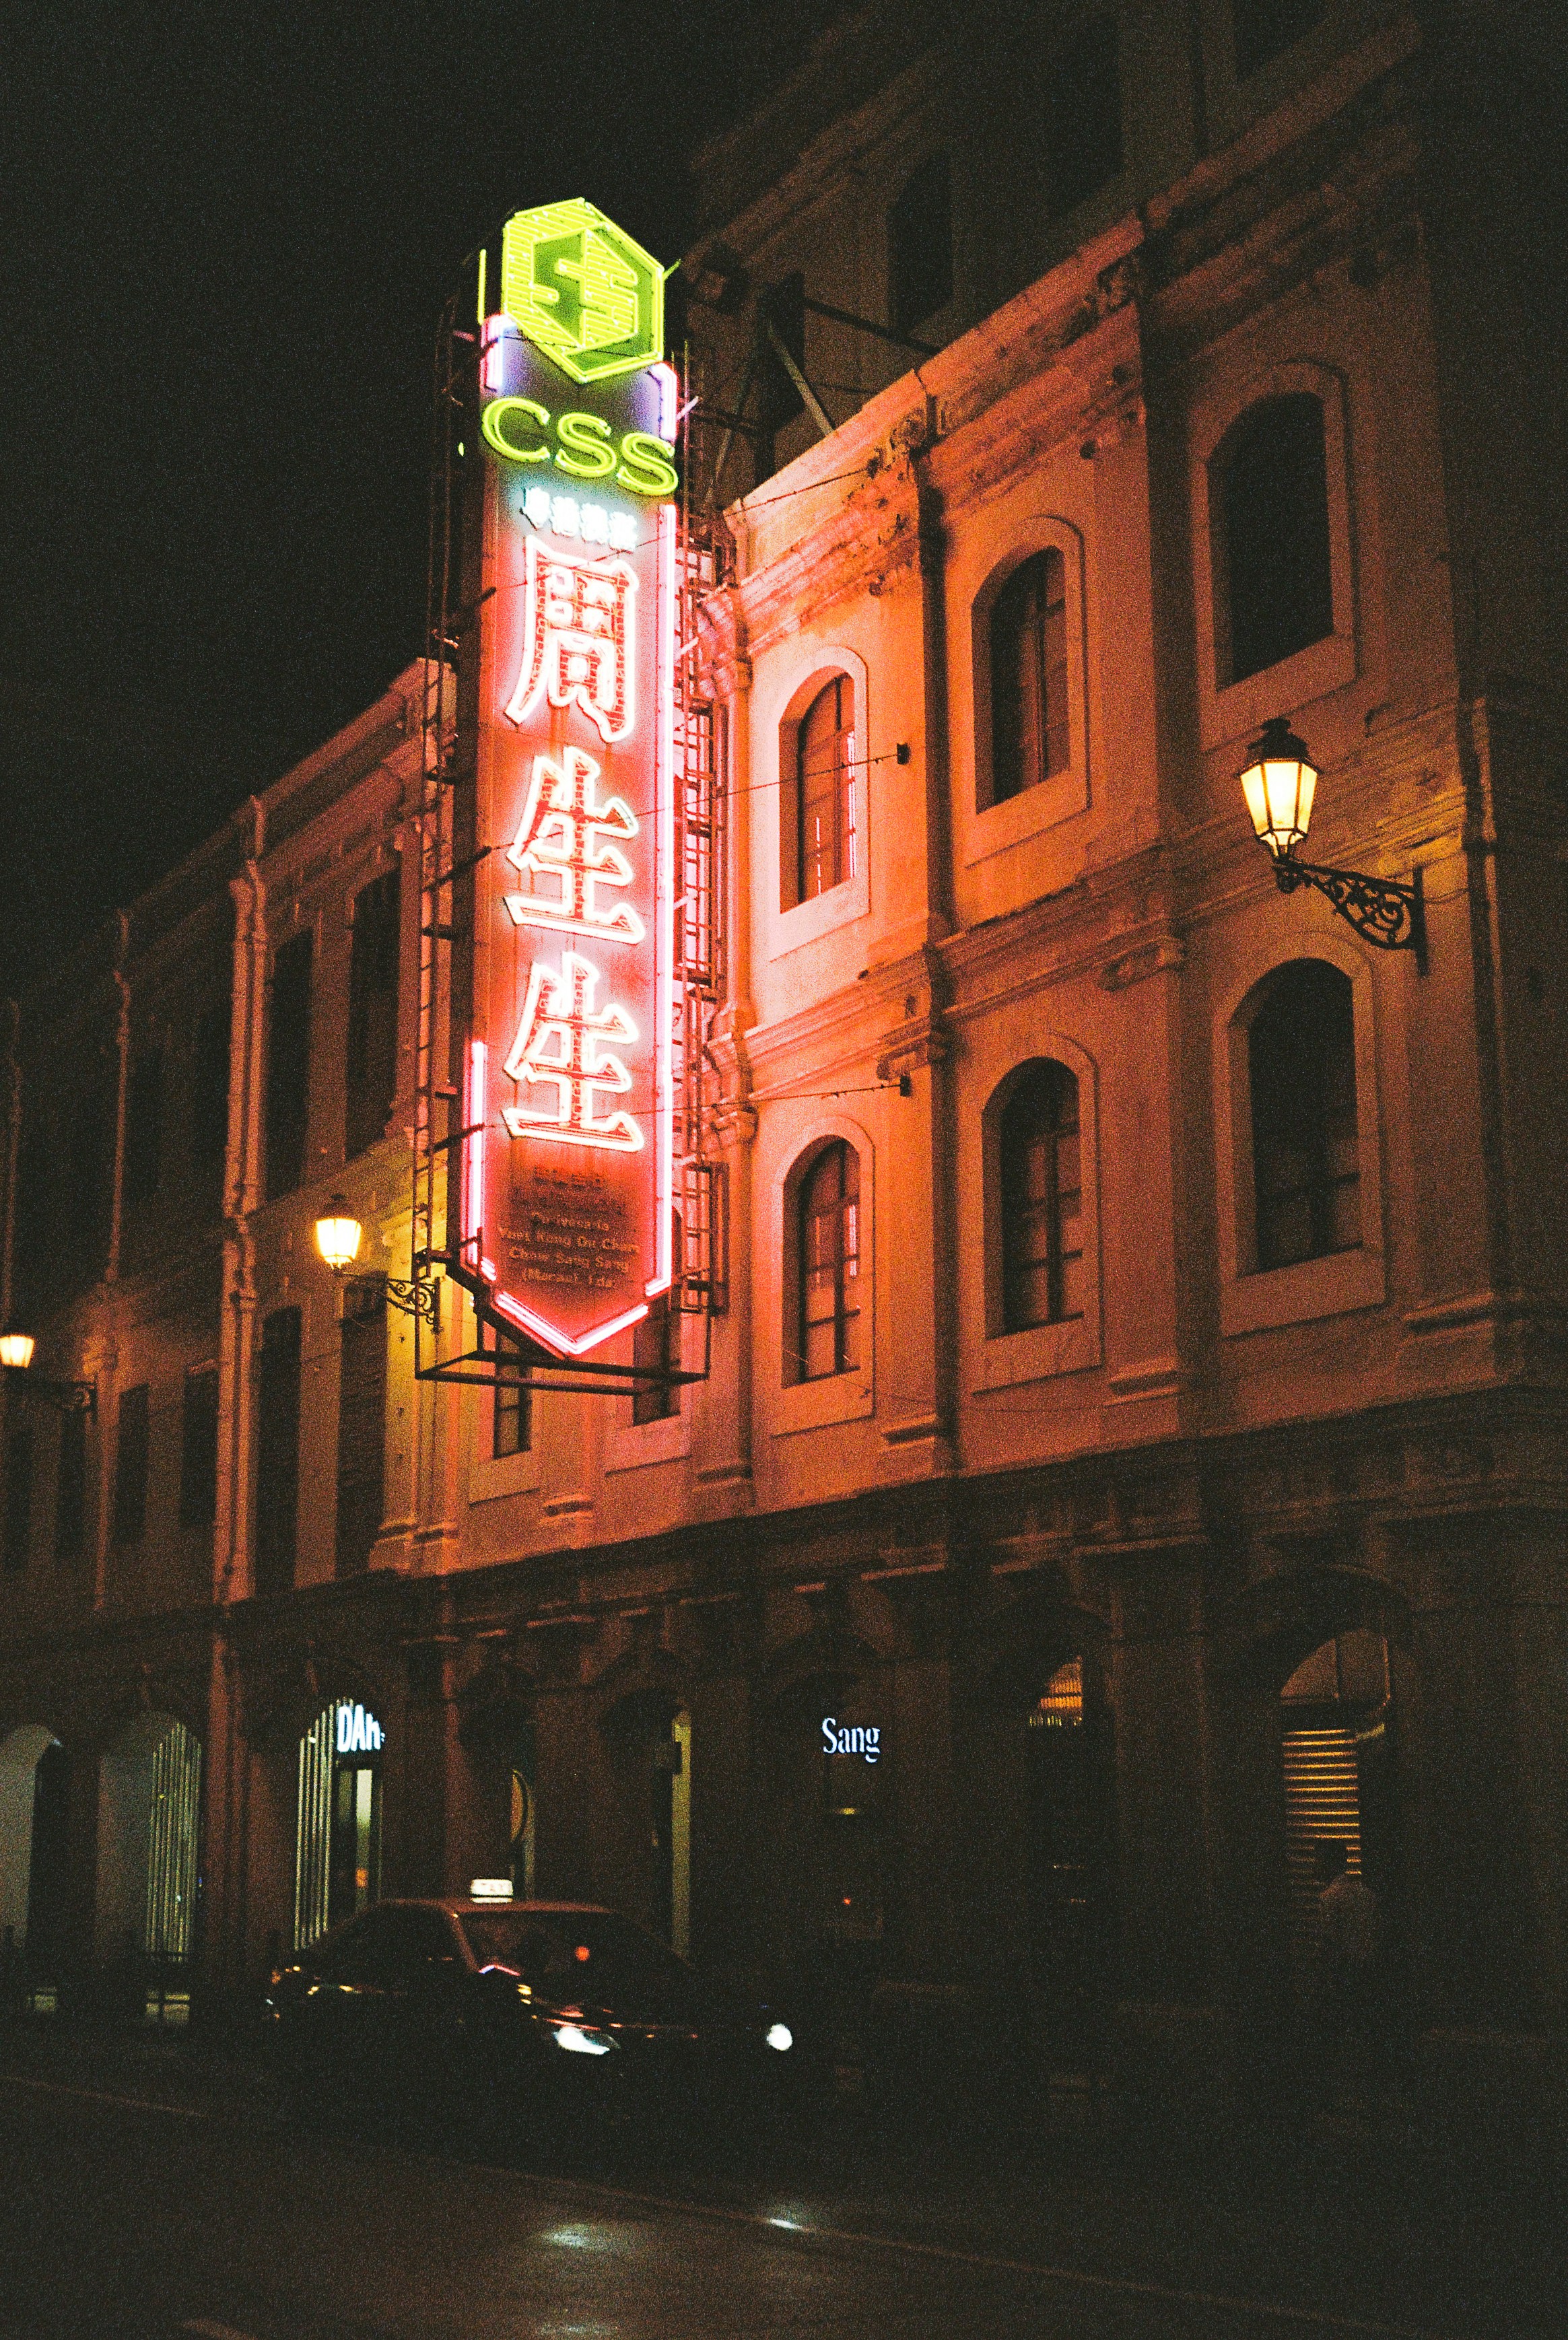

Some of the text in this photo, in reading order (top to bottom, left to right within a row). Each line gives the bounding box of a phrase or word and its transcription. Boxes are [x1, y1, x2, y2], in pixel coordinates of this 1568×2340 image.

[481, 396, 679, 496] CSS
[504, 536, 644, 1152] 周生生
[821, 1717, 881, 1763] Sang
